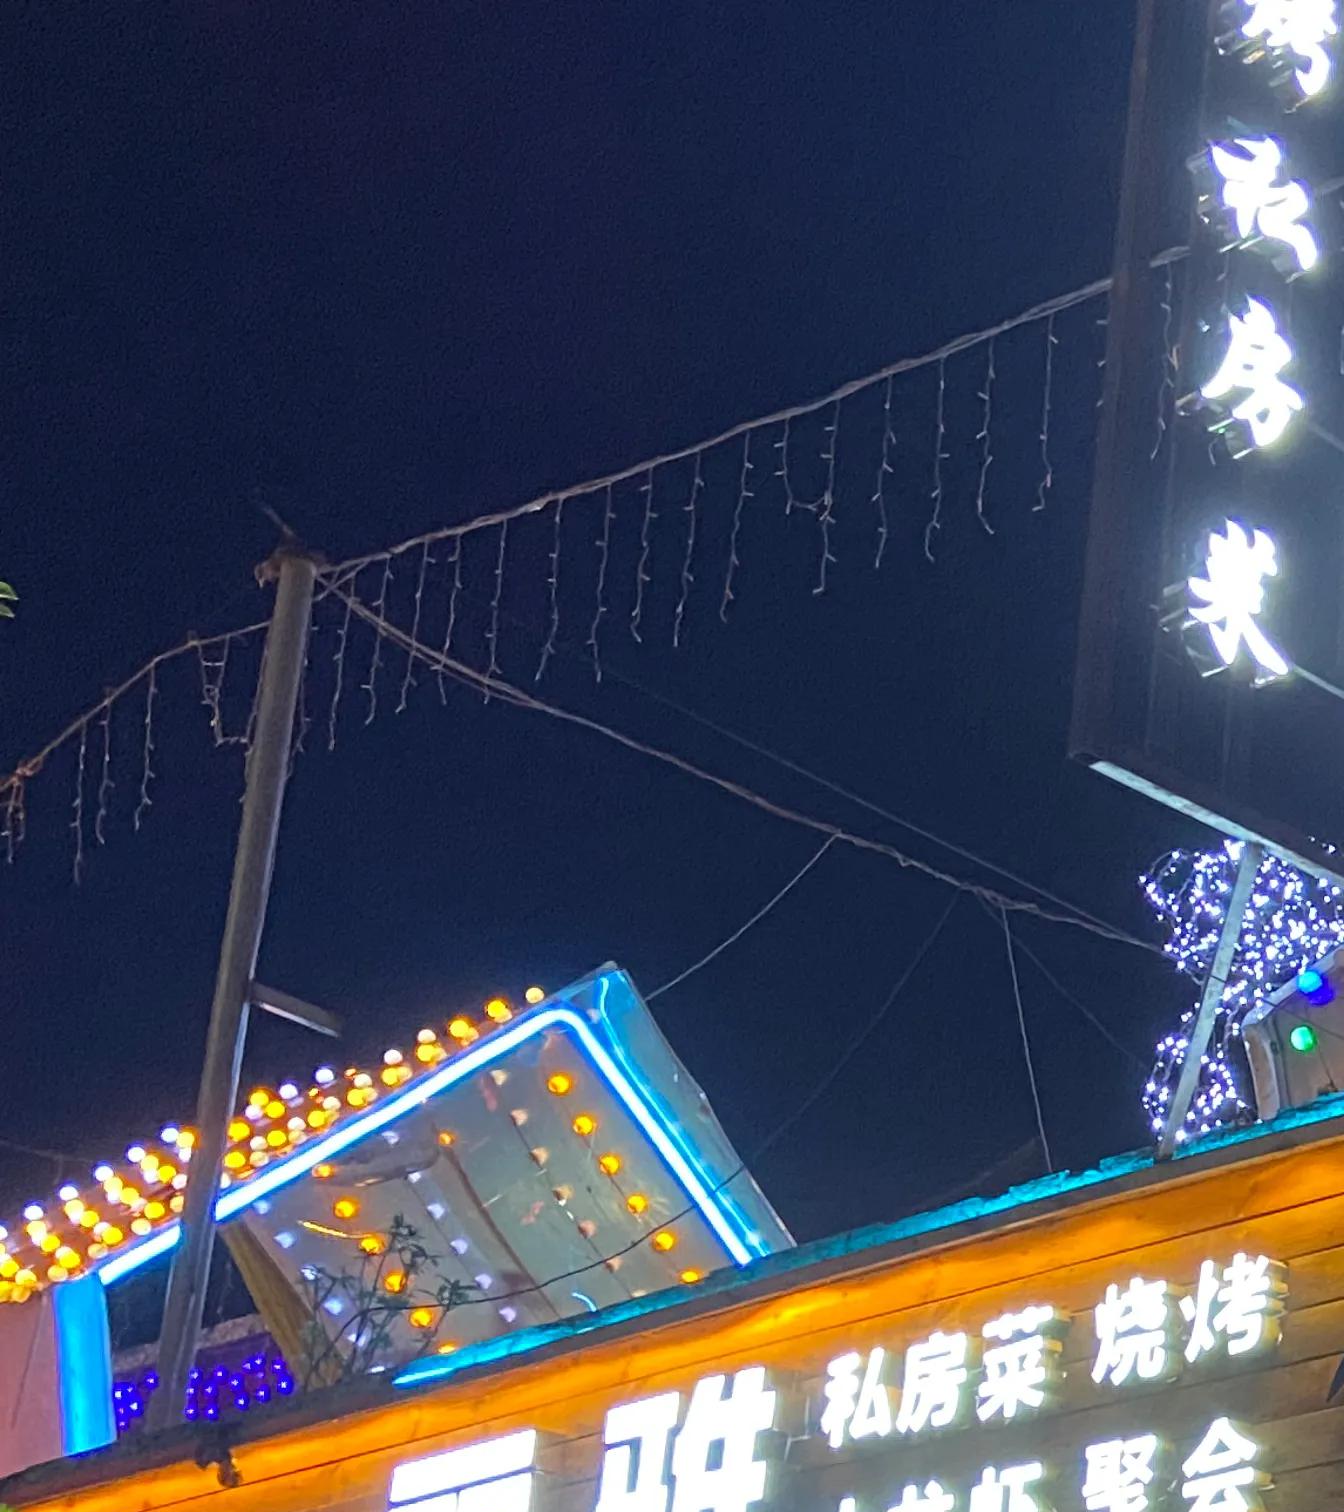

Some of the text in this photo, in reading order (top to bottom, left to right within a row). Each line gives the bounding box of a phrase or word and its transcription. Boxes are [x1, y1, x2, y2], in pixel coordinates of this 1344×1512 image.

[820, 1252, 1272, 1449] 私房菜 烧烤
